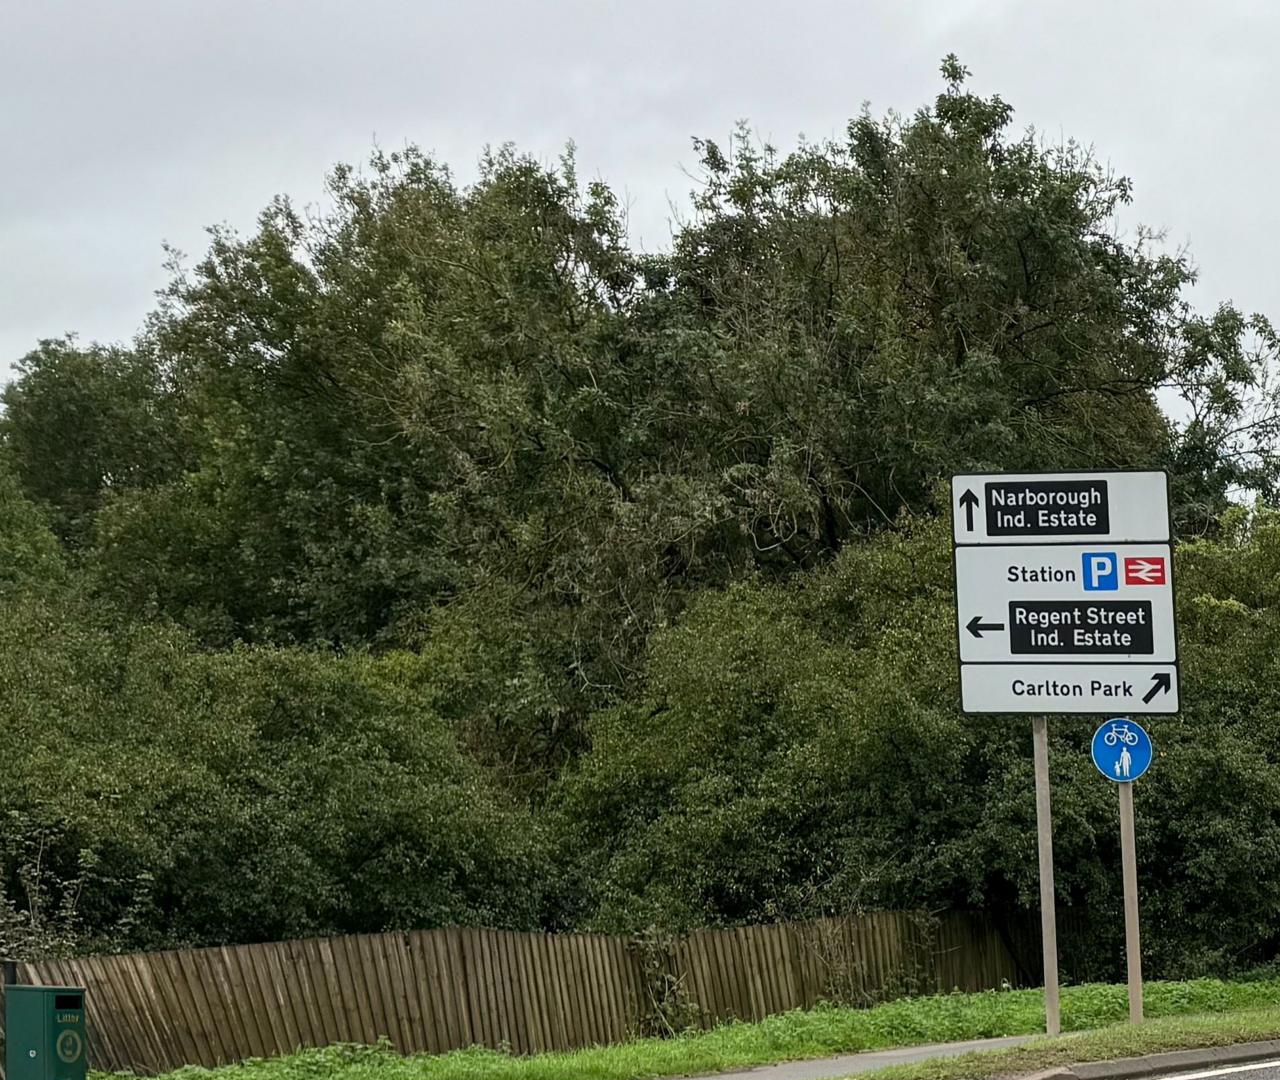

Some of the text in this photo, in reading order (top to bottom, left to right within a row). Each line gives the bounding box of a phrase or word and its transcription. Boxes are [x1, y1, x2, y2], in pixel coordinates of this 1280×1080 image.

[991, 487, 1101, 508] Narborough
[997, 510, 1097, 528] Ind. Estate
[1007, 557, 1112, 587] Station P
[1015, 607, 1145, 628] Regent Street
[1031, 629, 1132, 646] Ind. Estate
[1012, 679, 1133, 697] Carlton Park
[56, 1013, 80, 1023] Litter
